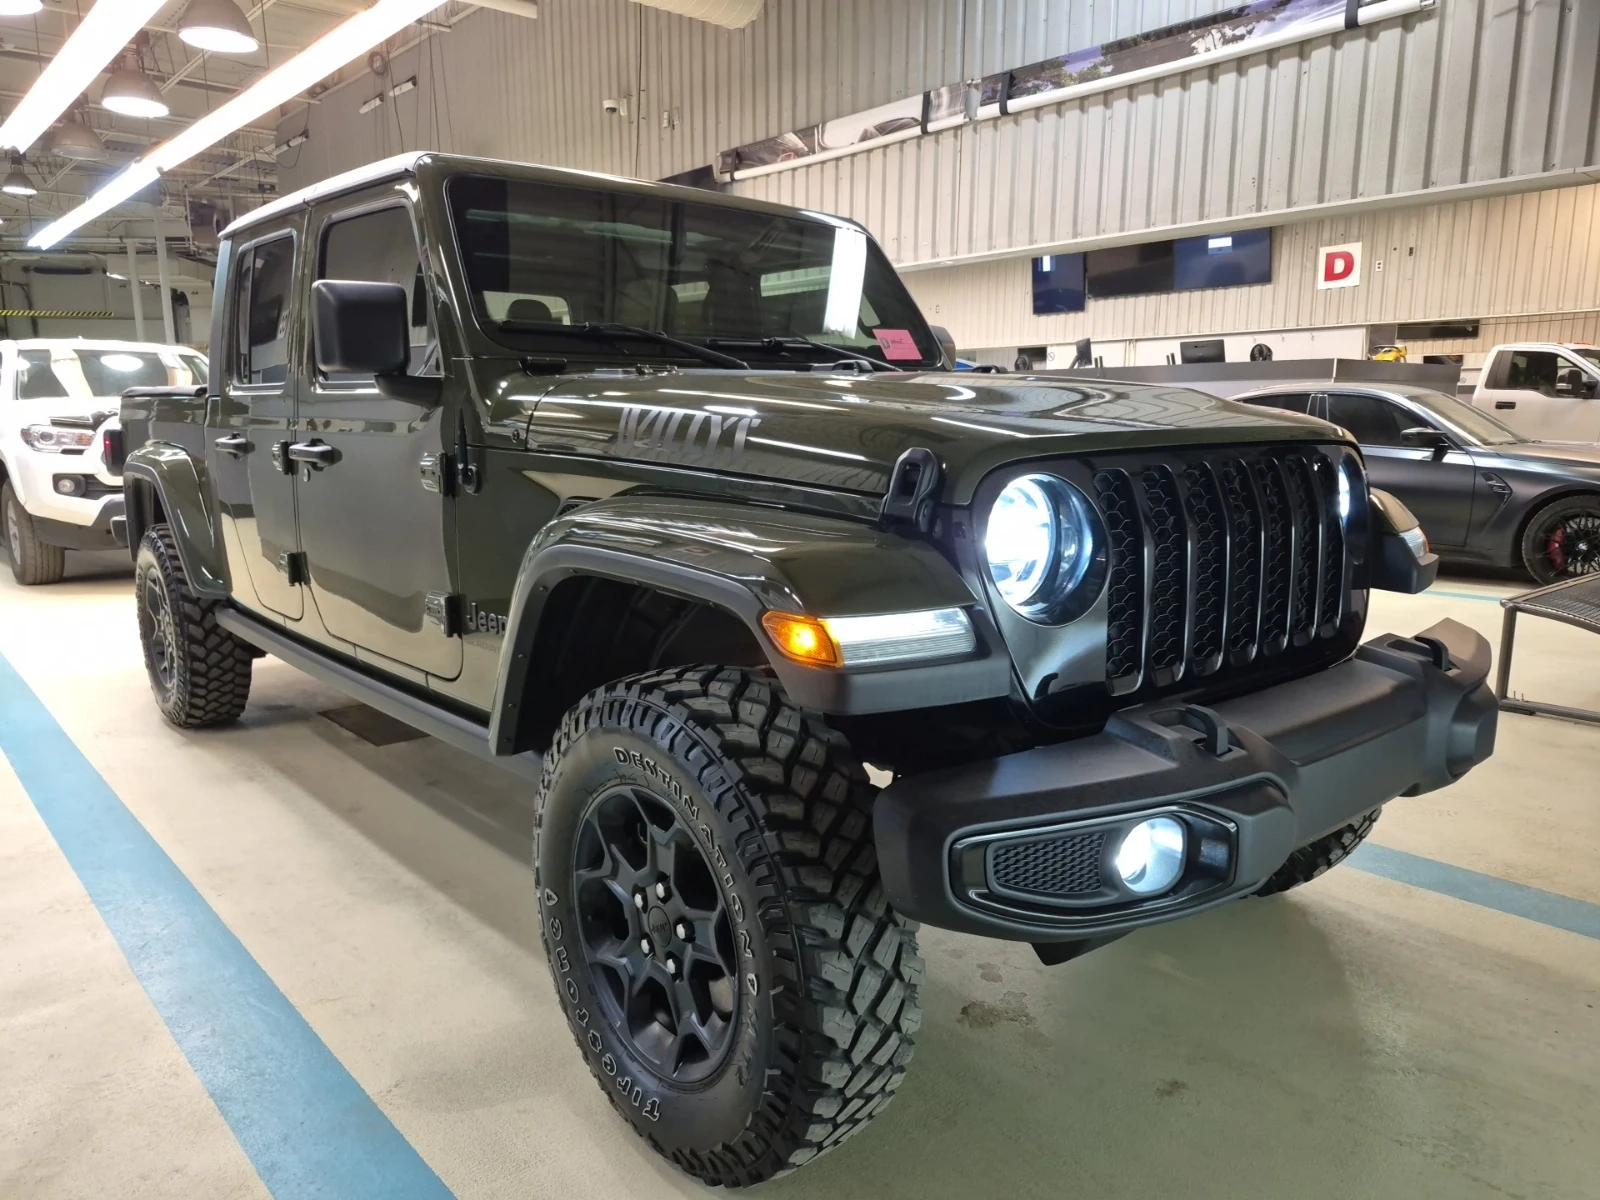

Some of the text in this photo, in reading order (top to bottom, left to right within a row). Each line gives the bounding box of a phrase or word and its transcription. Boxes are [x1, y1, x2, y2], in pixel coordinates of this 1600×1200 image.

[1324, 251, 1355, 282] D
[466, 602, 508, 638] Jeep
[613, 746, 754, 958] DESTINATION
